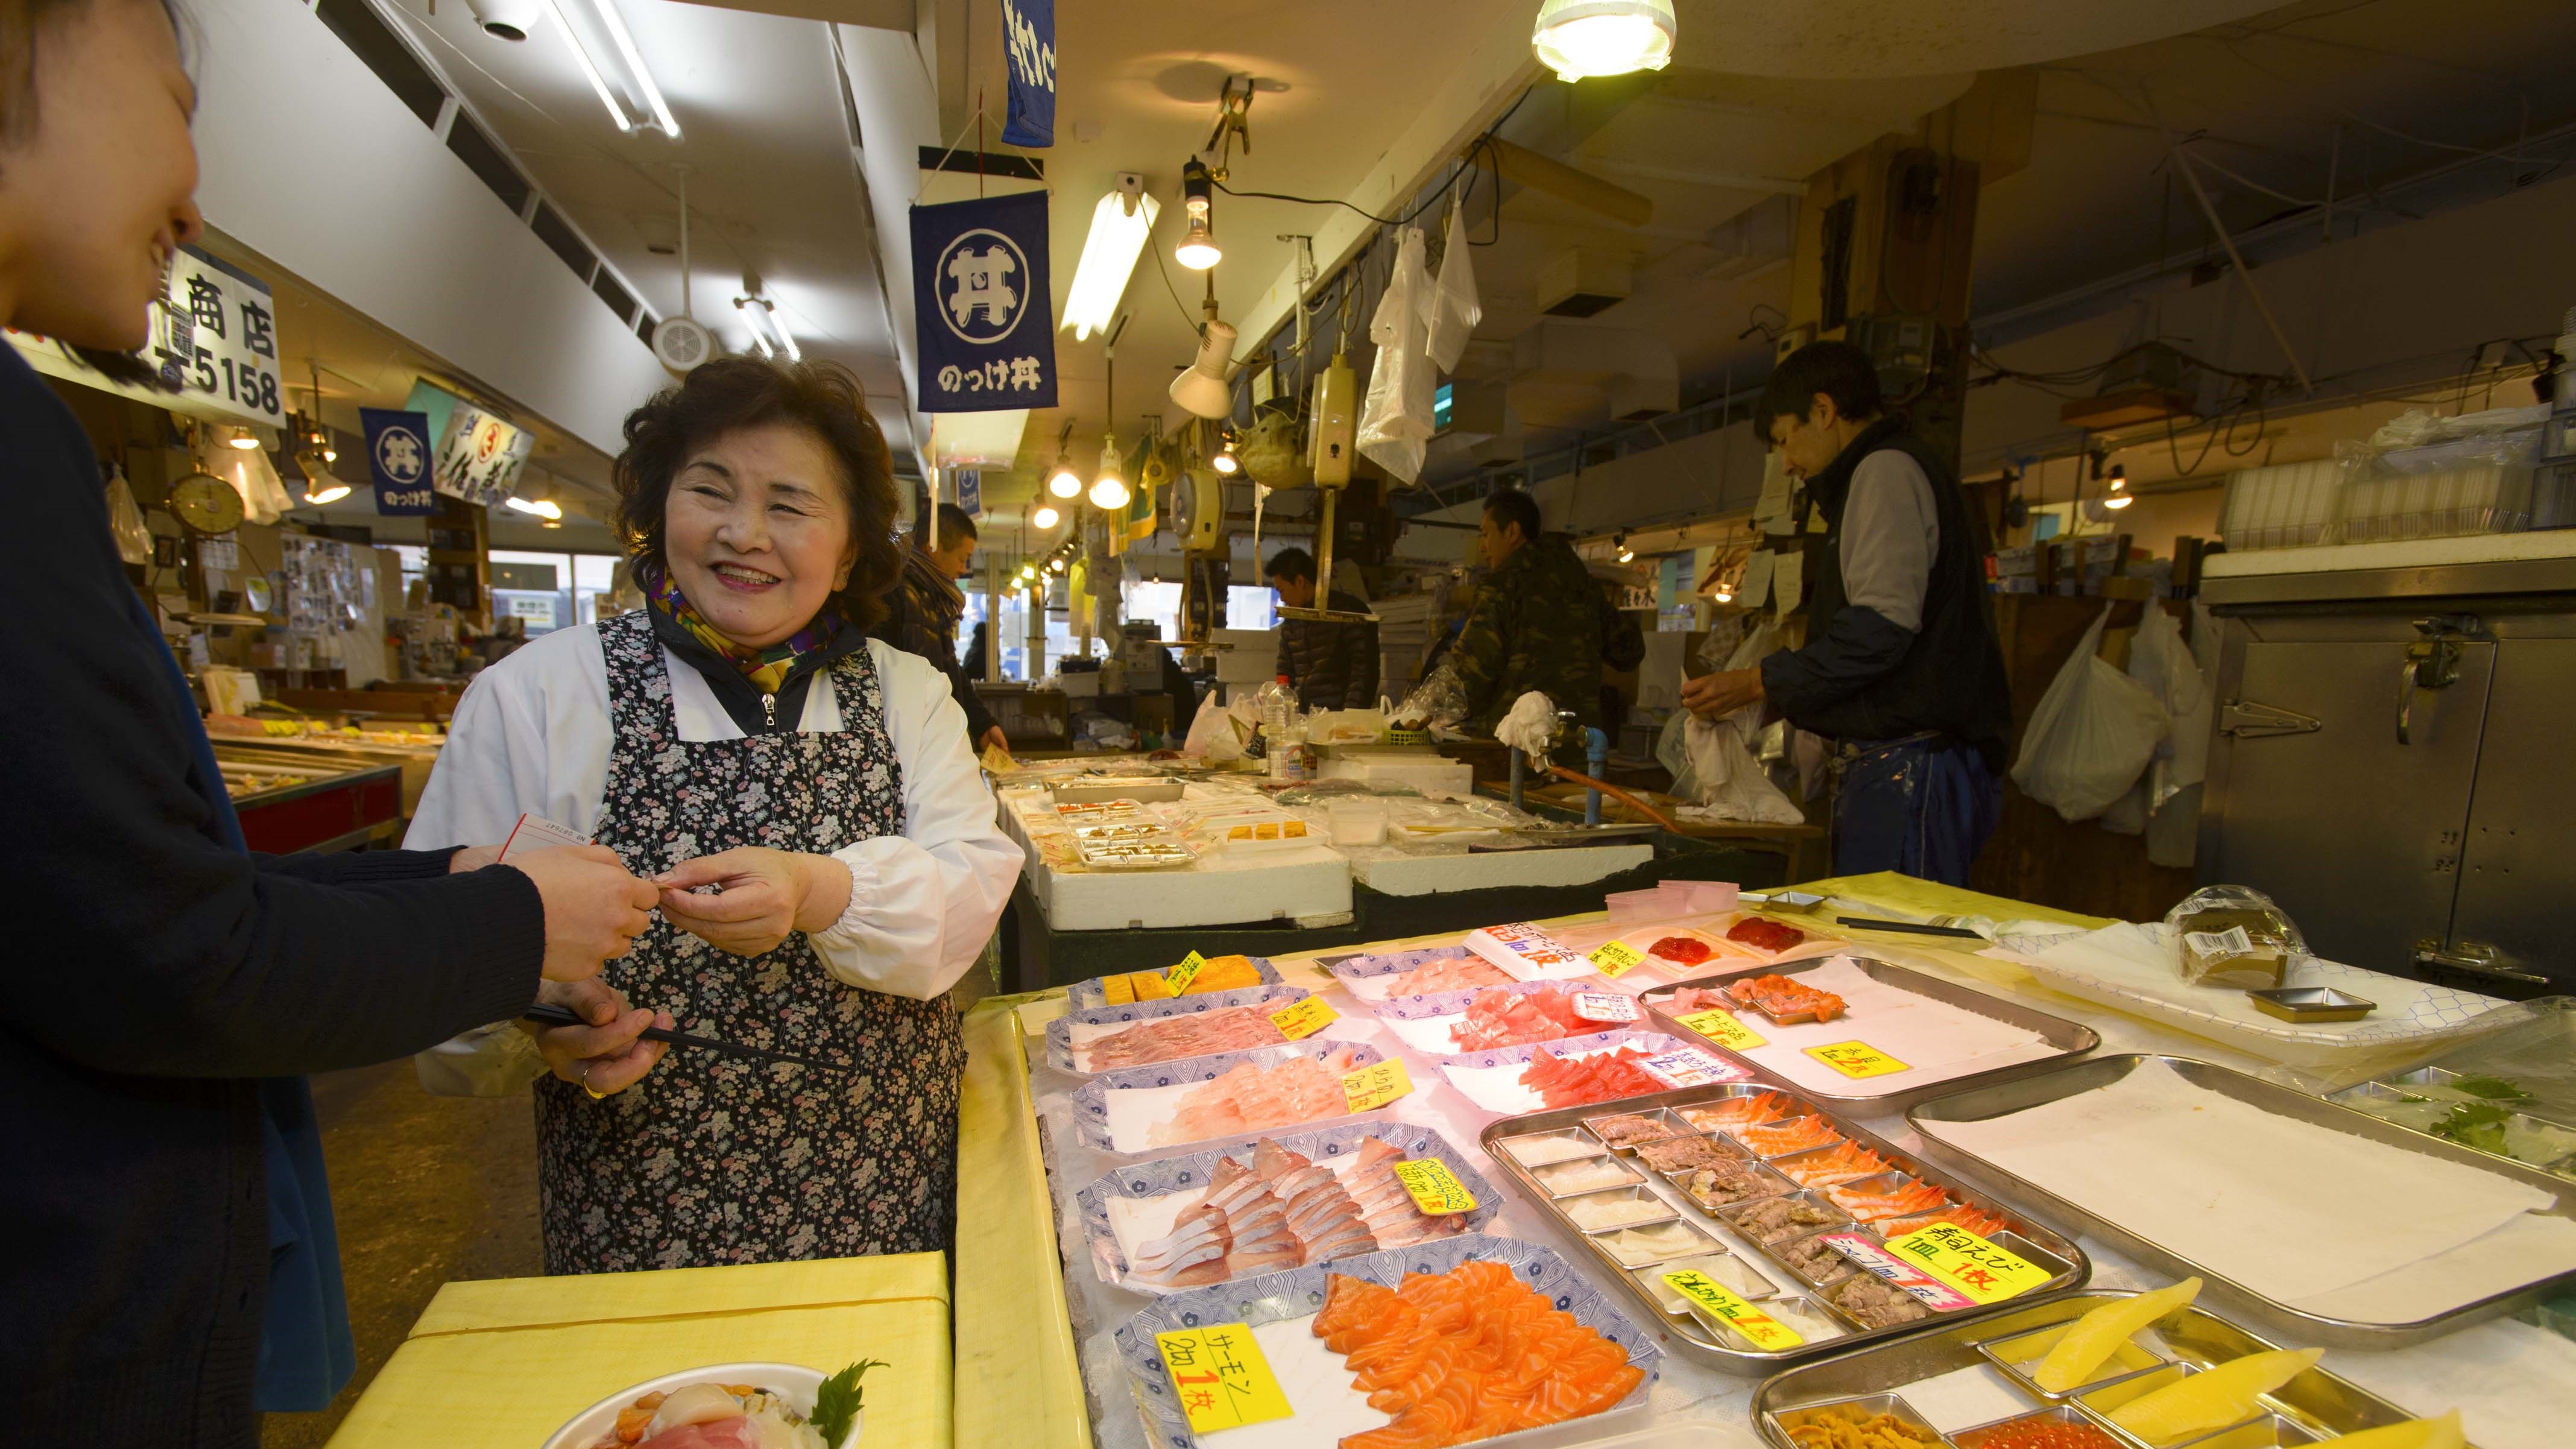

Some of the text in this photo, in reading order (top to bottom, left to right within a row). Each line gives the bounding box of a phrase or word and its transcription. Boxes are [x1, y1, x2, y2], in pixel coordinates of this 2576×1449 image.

[186, 273, 274, 359] 商店
[938, 355, 1042, 393] のっけ丼
[384, 490, 432, 508] のっけ丼
[1506, 922, 1582, 962] 本日のサービス品
[1705, 1012, 1746, 1041] サービス品
[1842, 1048, 1881, 1063] 赤貝
[1375, 1069, 1394, 1094] ひらめ
[1826, 1239, 1883, 1264] シャコ
[1903, 1236, 1999, 1292] 1皿 1枚
[1925, 1227, 2024, 1272] 寿司えび
[1207, 1334, 1251, 1395] サーモン
[1176, 1369, 1220, 1416] 1枚
